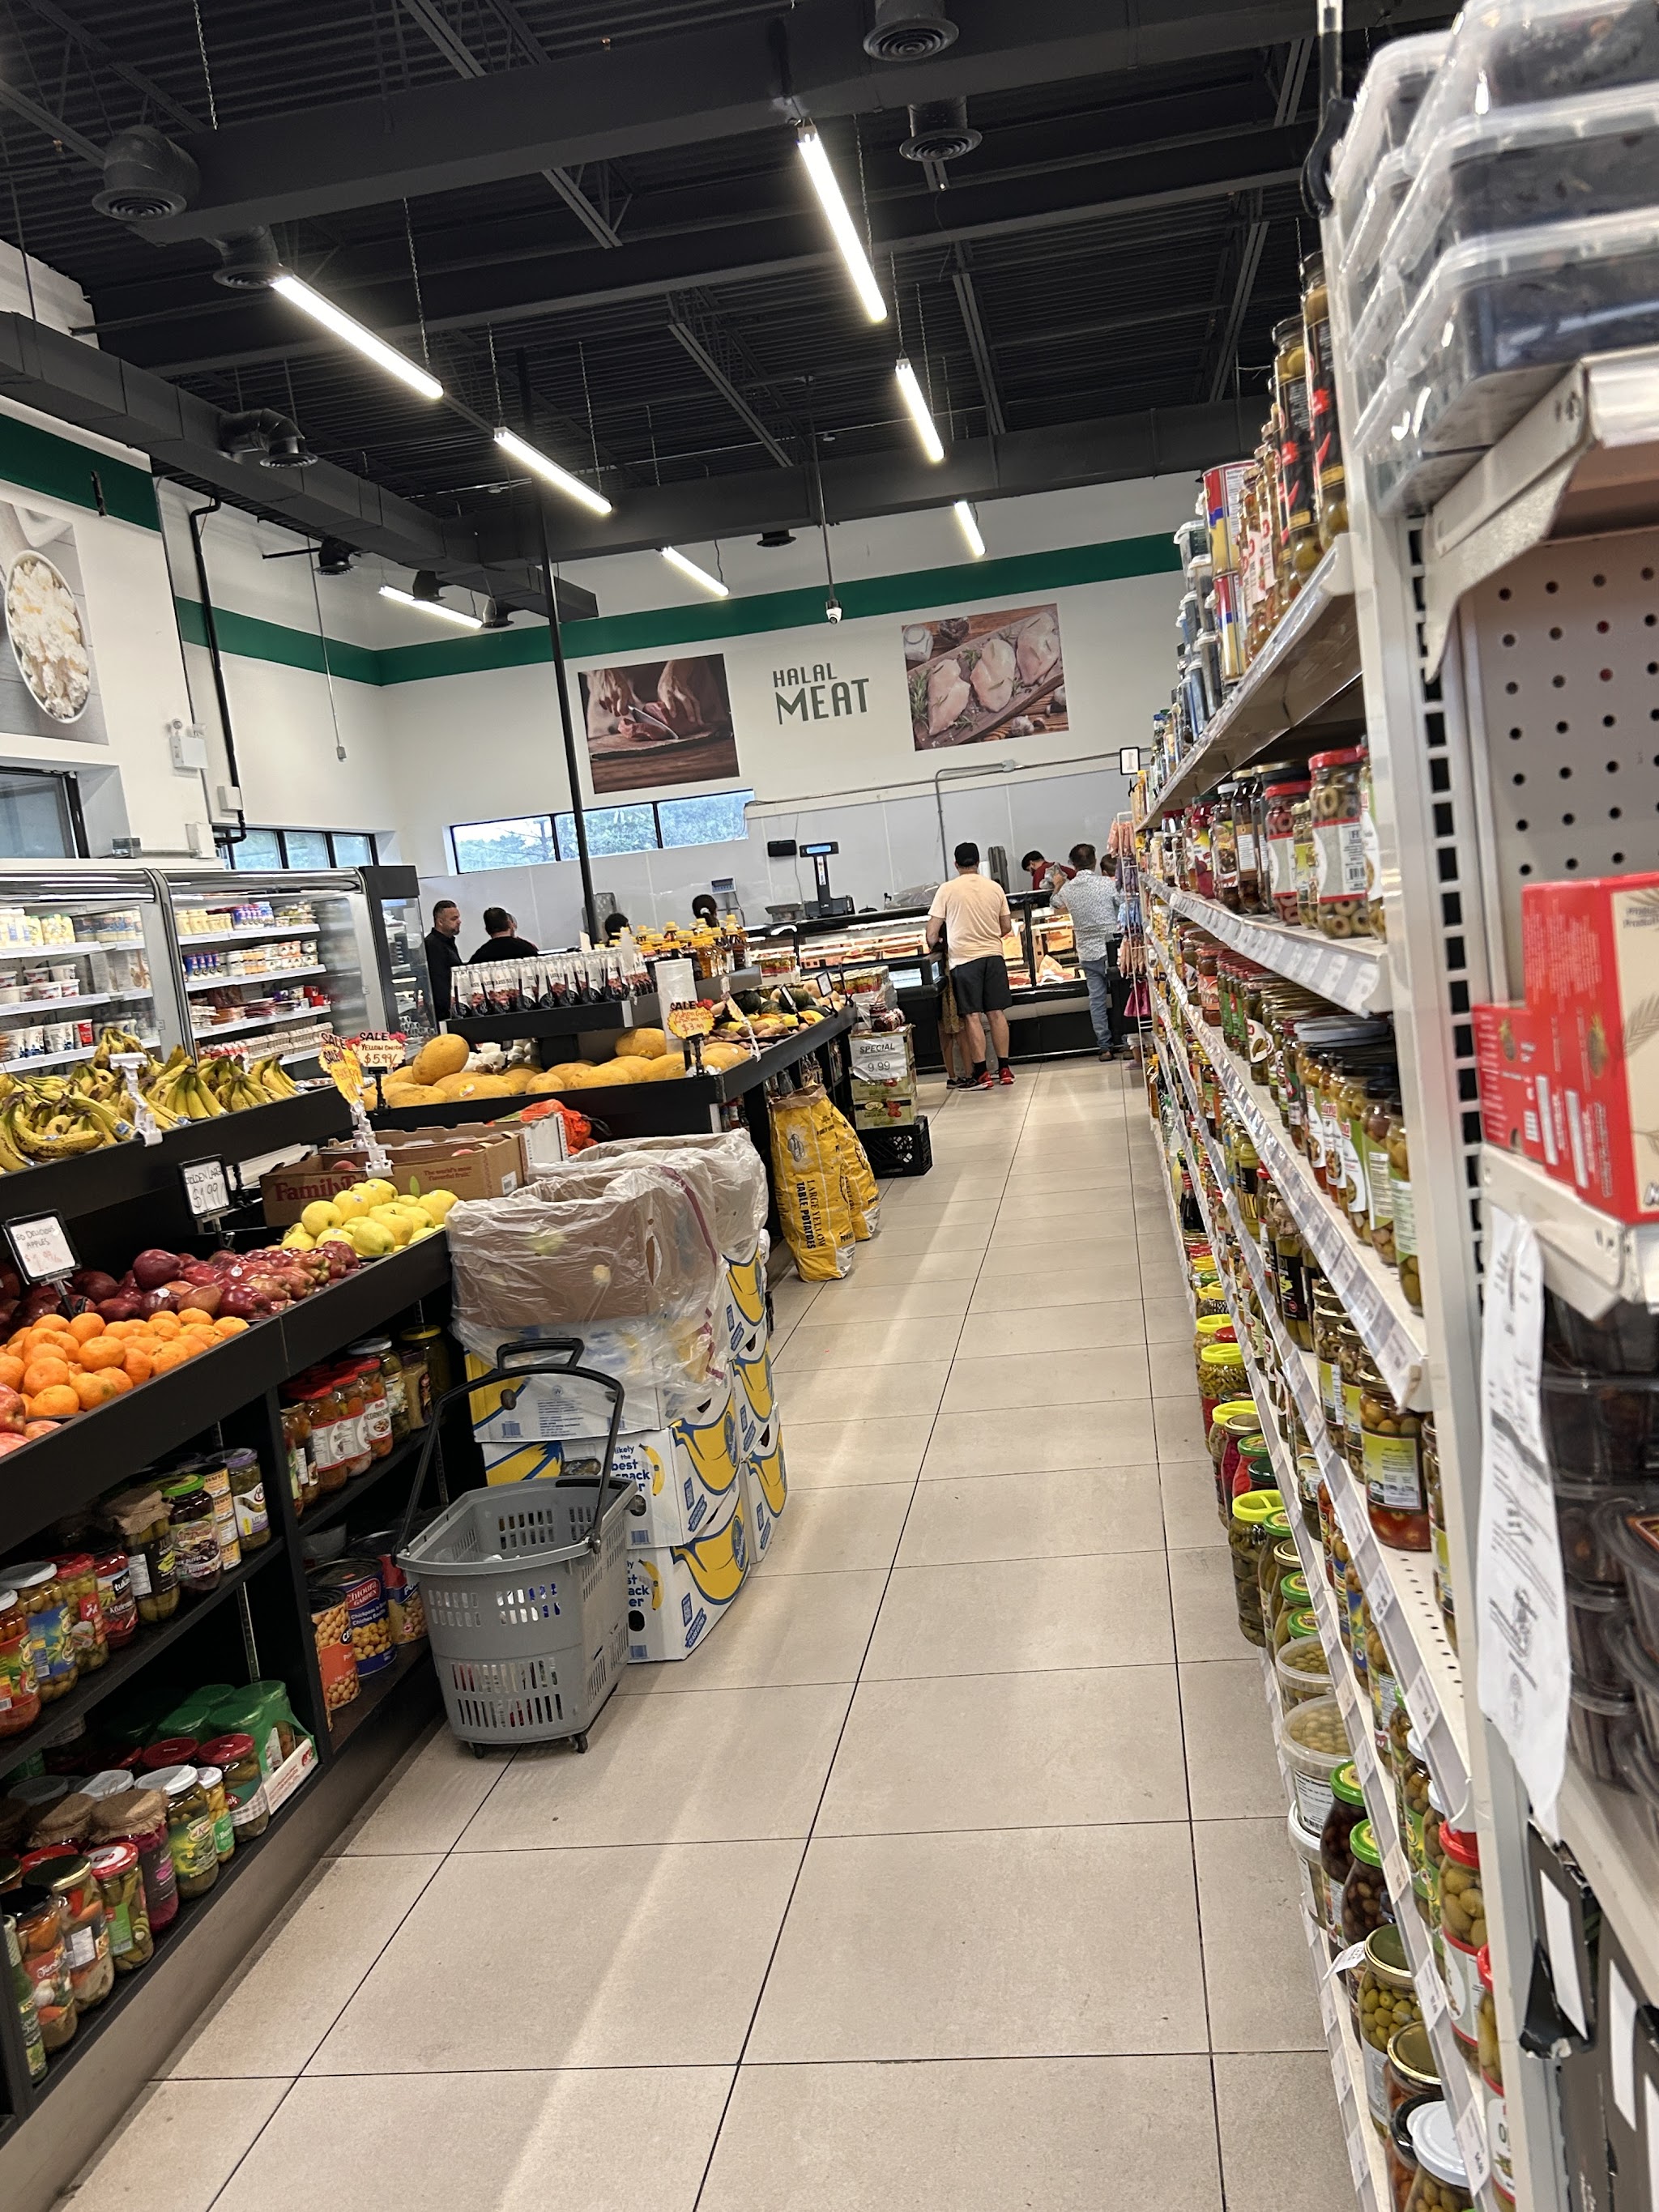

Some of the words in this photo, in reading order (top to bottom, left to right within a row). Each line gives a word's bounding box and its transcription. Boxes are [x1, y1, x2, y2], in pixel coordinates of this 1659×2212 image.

[773, 663, 838, 688] HALAL
[775, 678, 869, 725] MEAT
[671, 1000, 697, 1012] SALE
[360, 1032, 389, 1042] SALE
[361, 1043, 384, 1051] YELLOW
[859, 1042, 896, 1054] SPECIAL
[868, 1061, 891, 1072] 9.99
[796, 1181, 809, 1209] TABLE
[806, 1179, 820, 1211] LARGE
[800, 1208, 817, 1249] POTATOES
[812, 1210, 827, 1247] YELLOW
[27, 1238, 50, 1249] APPLES
[612, 1459, 638, 1472] best
